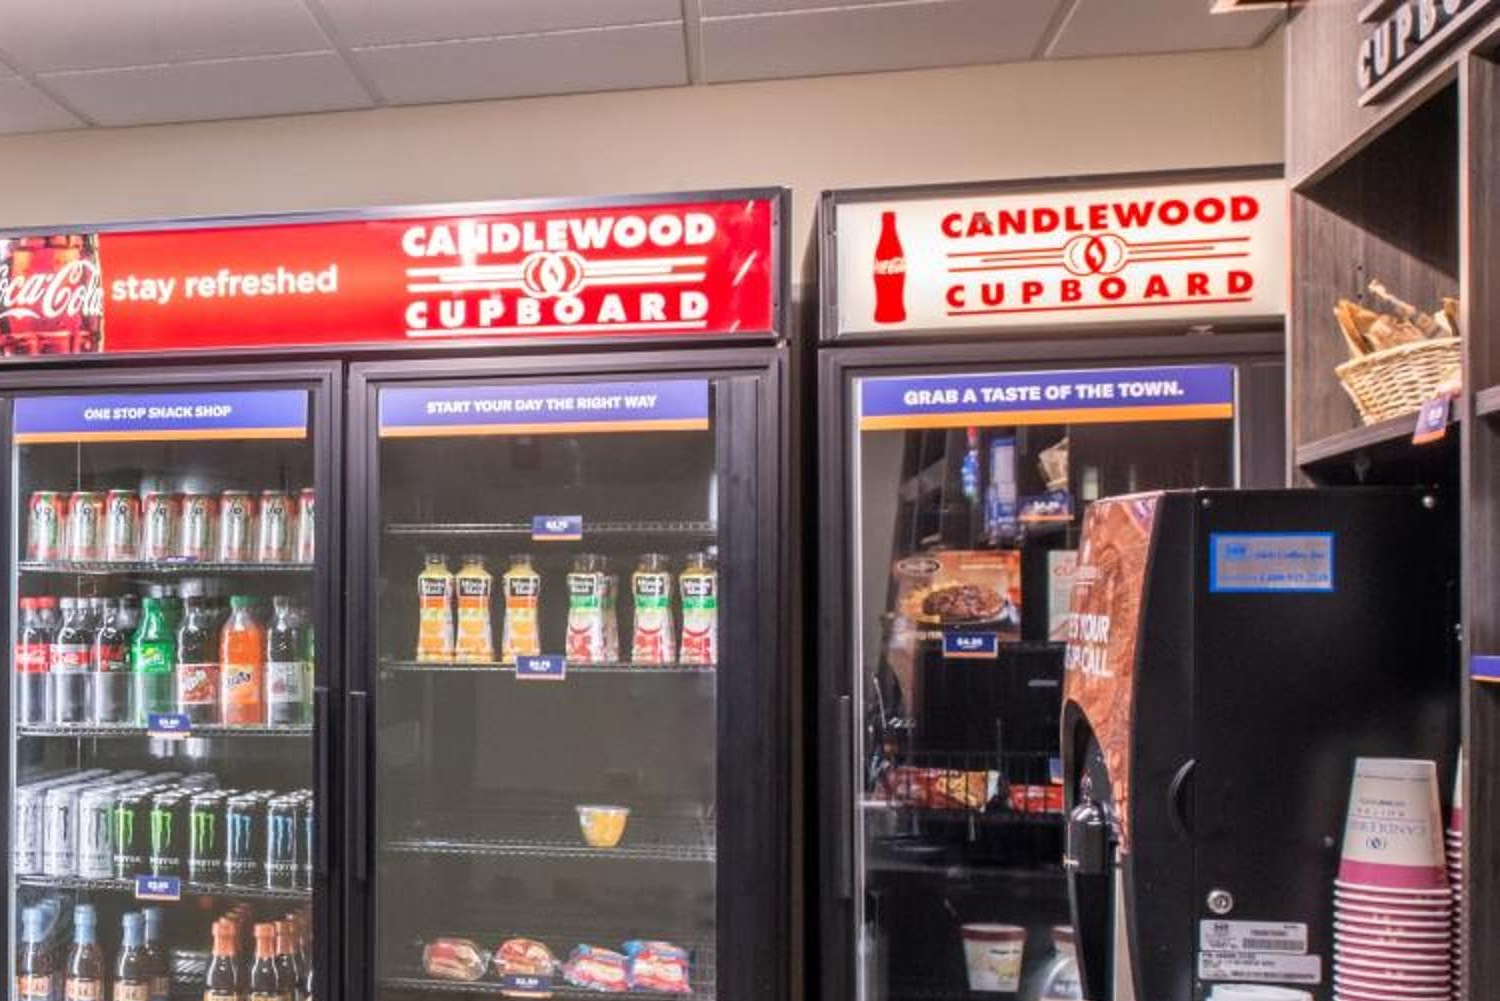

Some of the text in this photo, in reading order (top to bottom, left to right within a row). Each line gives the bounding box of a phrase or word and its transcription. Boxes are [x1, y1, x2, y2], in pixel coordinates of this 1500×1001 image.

[1357, 0, 1460, 88] CUPB
[402, 212, 716, 256] CANDLEWOOD
[941, 196, 1259, 238] CANDLEWOOD
[111, 264, 339, 304] stay refreshed
[946, 270, 1254, 307] CUPBOARD
[405, 291, 709, 329] CUPBOARD
[84, 405, 232, 420] ONE STOP SNACK SHOP
[427, 395, 657, 414] START YOUR DAY THE RIGHT WAY
[904, 381, 1184, 406] GRAB A TASTE OF THE TOWN.
